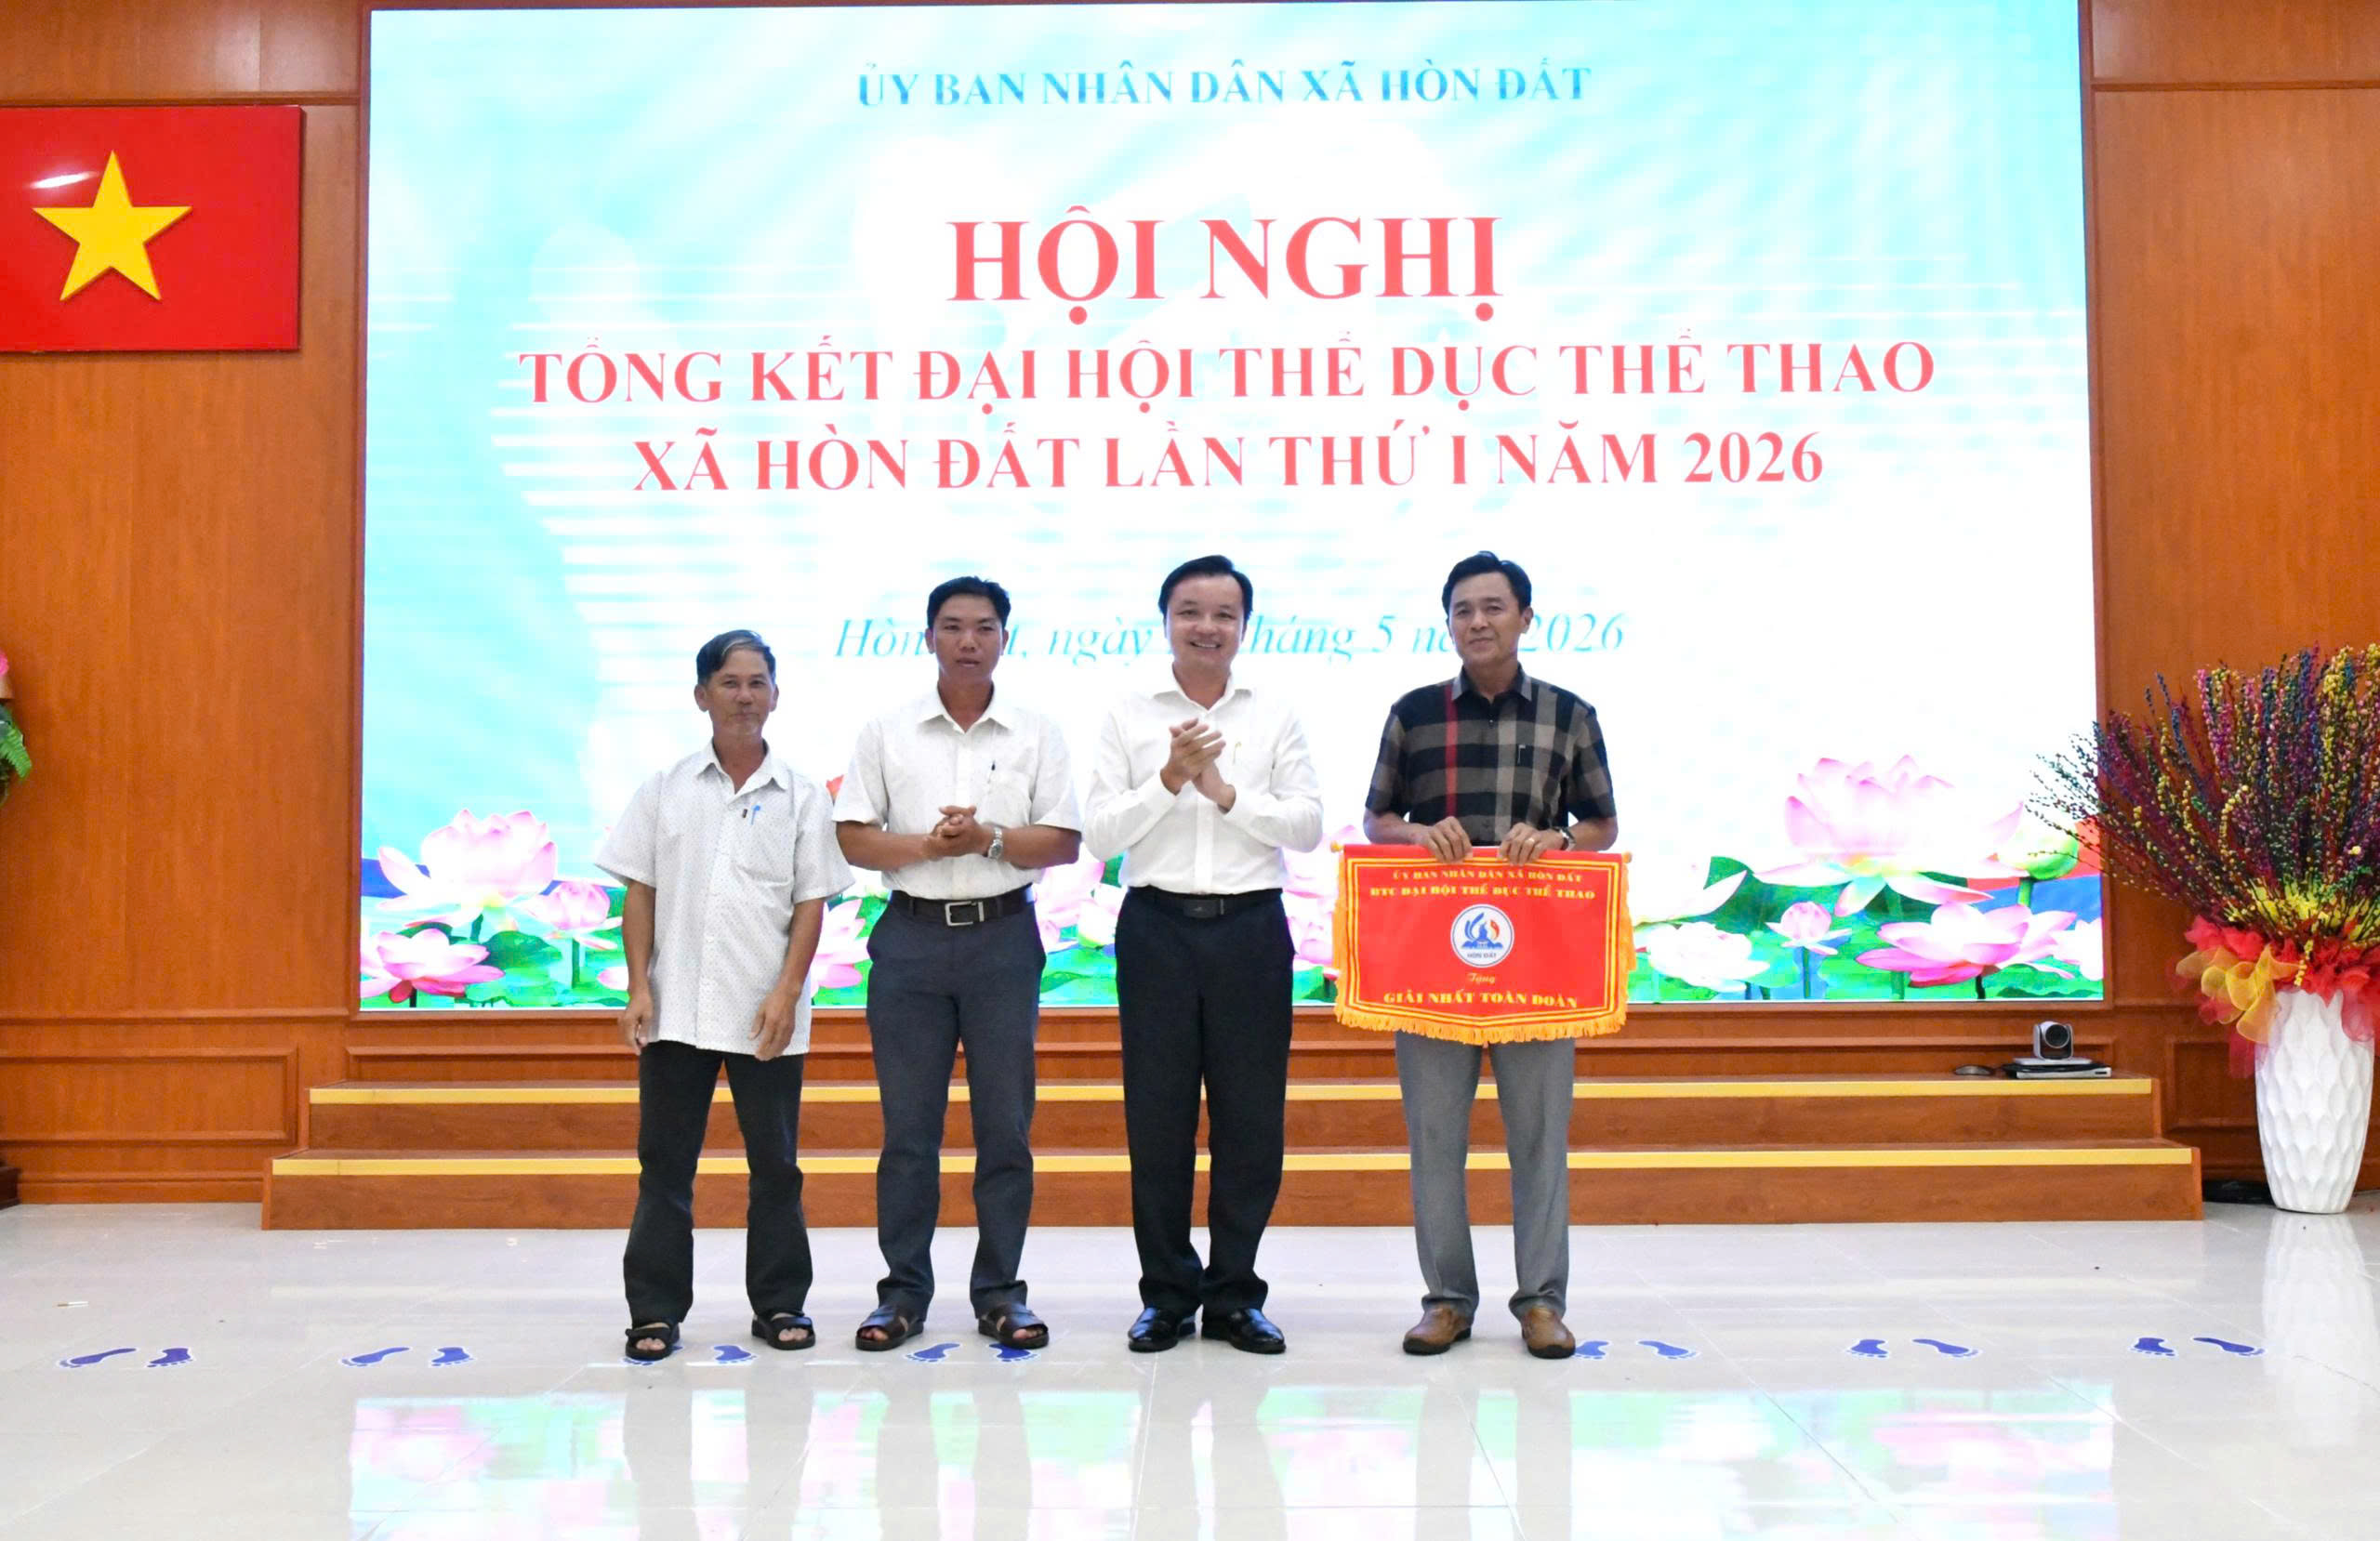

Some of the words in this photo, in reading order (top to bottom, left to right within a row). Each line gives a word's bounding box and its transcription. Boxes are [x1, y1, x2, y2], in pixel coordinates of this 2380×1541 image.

[859, 60, 919, 106] ỦY
[934, 72, 1025, 105] BAN
[1042, 59, 1173, 104] NHÂN
[1190, 59, 1285, 104] DÂN
[1302, 59, 1364, 102] XÃ
[1381, 59, 1481, 102] HÒN
[1495, 57, 1593, 101] ĐẤT
[945, 204, 1166, 325] HỘI
[1199, 216, 1504, 322] NGHỊ
[518, 335, 723, 403] TỔNG
[749, 334, 894, 402] KẾT
[913, 349, 1038, 415] ĐẠI
[1066, 339, 1196, 415] HỘI
[1219, 330, 1365, 398] THỂ
[1391, 345, 1539, 412] DỤC
[1558, 328, 1706, 395] THỂ
[1726, 340, 1936, 394] THAO
[632, 426, 729, 492] XÃ
[755, 423, 908, 491] HÒN
[932, 421, 1081, 489] ĐẤT
[1104, 420, 1246, 488] LẦN
[1269, 418, 1431, 487] THỨ
[1451, 434, 1468, 485] I
[1497, 420, 1659, 485] NĂM
[1684, 431, 1824, 483] 2026
[1048, 616, 1153, 667] ngày
[1248, 613, 1356, 665] háng
[1372, 613, 1395, 655] 5
[1382, 989, 1424, 1005] GIẢI
[1428, 988, 1476, 1005] NHẤT
[1479, 989, 1527, 1005] TOÀN
[1531, 993, 1579, 1009] ĐOÀN
